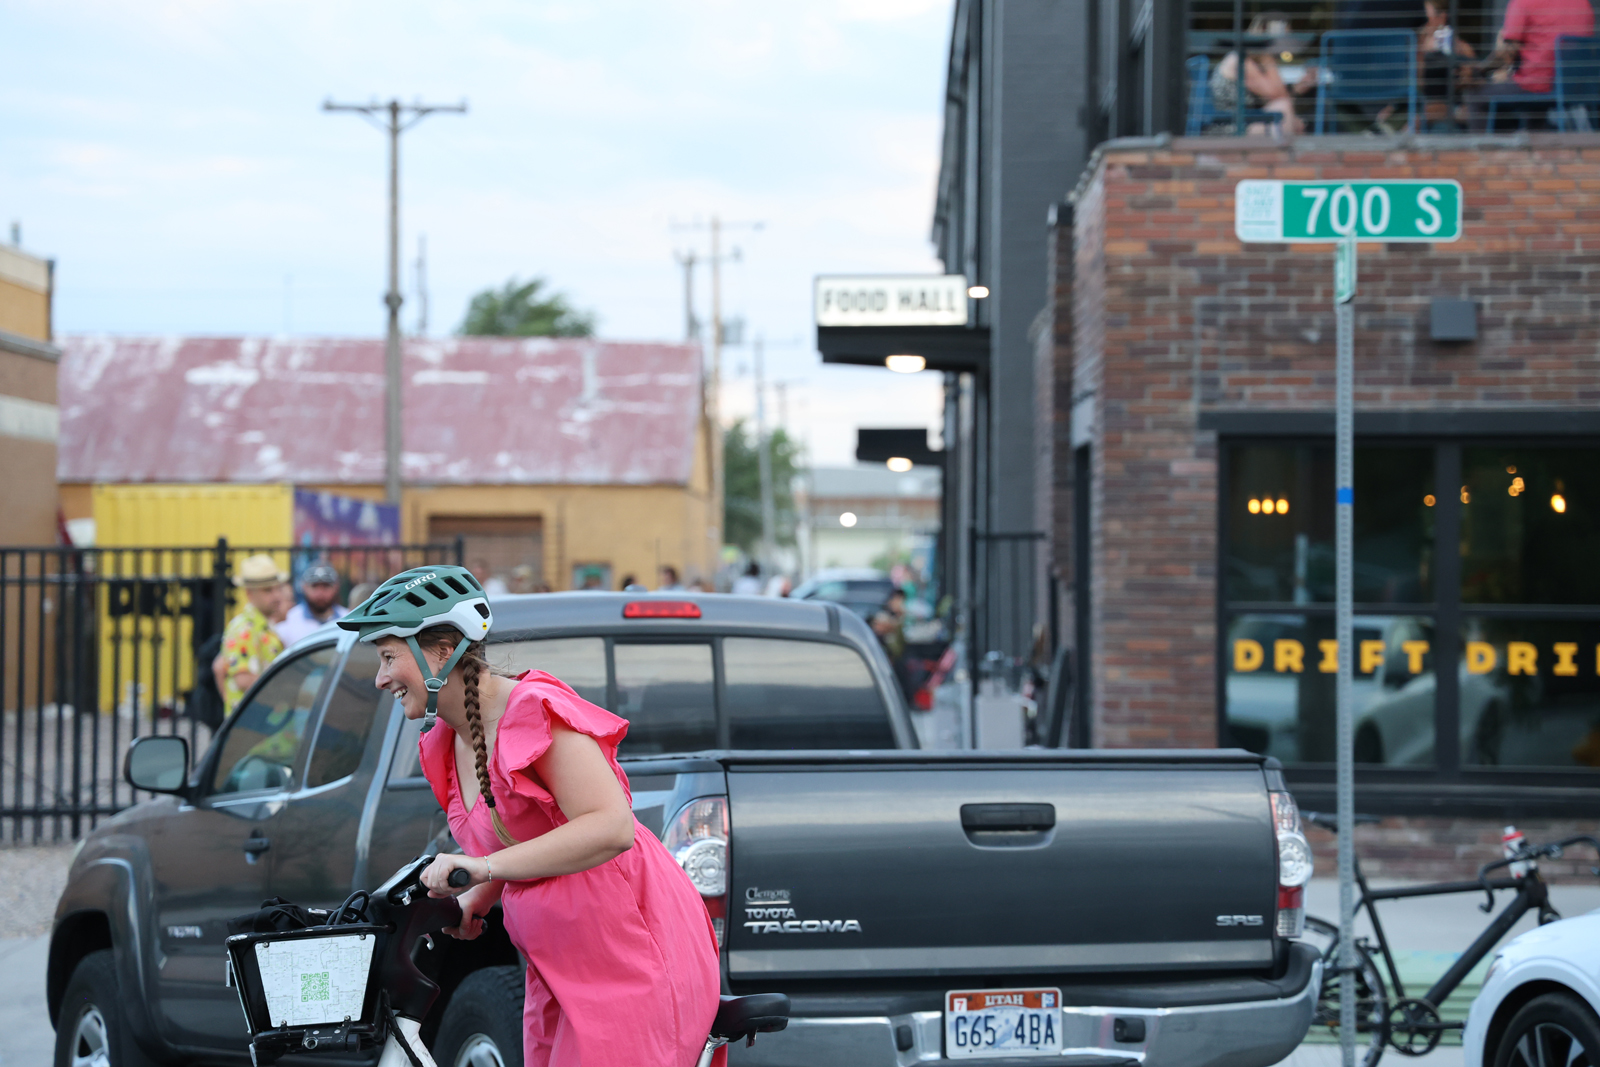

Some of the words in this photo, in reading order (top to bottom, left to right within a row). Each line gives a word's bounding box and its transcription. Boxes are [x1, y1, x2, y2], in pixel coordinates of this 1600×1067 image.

[1301, 186, 1390, 235] 700
[1415, 186, 1442, 235] S
[823, 288, 888, 313] FOOD
[898, 288, 957, 312] HALL
[404, 572, 437, 590] GIRO
[1233, 638, 1430, 674] DRIFT
[1465, 641, 1600, 677] DRI
[745, 908, 796, 918] TOYOTA
[744, 920, 862, 933] TACOMA
[985, 994, 1024, 1006] UTAH
[955, 1015, 996, 1047] G65
[1015, 1013, 1055, 1045] 4BA
